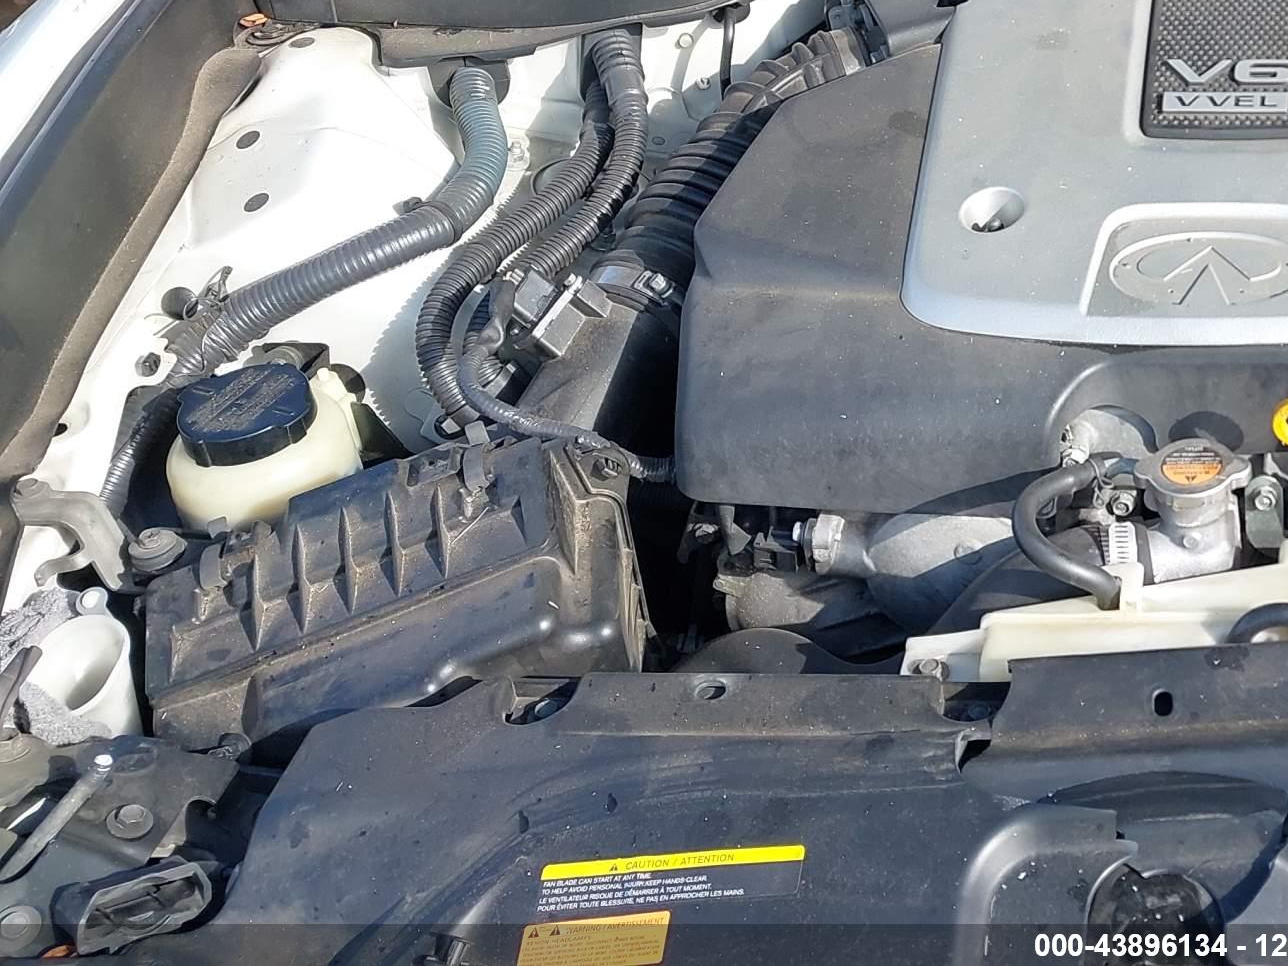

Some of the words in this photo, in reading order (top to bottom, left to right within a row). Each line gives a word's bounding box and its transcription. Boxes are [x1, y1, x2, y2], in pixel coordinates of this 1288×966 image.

[1176, 95, 1277, 107] VVEL
[625, 859, 669, 870] CAUTION
[680, 853, 735, 866] ATTENTION
[551, 887, 567, 895] HELP
[588, 883, 622, 892] PERSONAL
[662, 877, 685, 885] HANDS
[593, 876, 613, 884] START
[622, 873, 635, 881] ANY
[537, 904, 555, 912] POUR
[669, 891, 709, 900] APPROCHER
[548, 894, 589, 903] VENTILATEUR
[589, 892, 613, 900] RISQUE
[666, 885, 682, 893] TOUT
[566, 923, 601, 934] WARNING
[607, 917, 664, 930] AVERTISSEMENT
